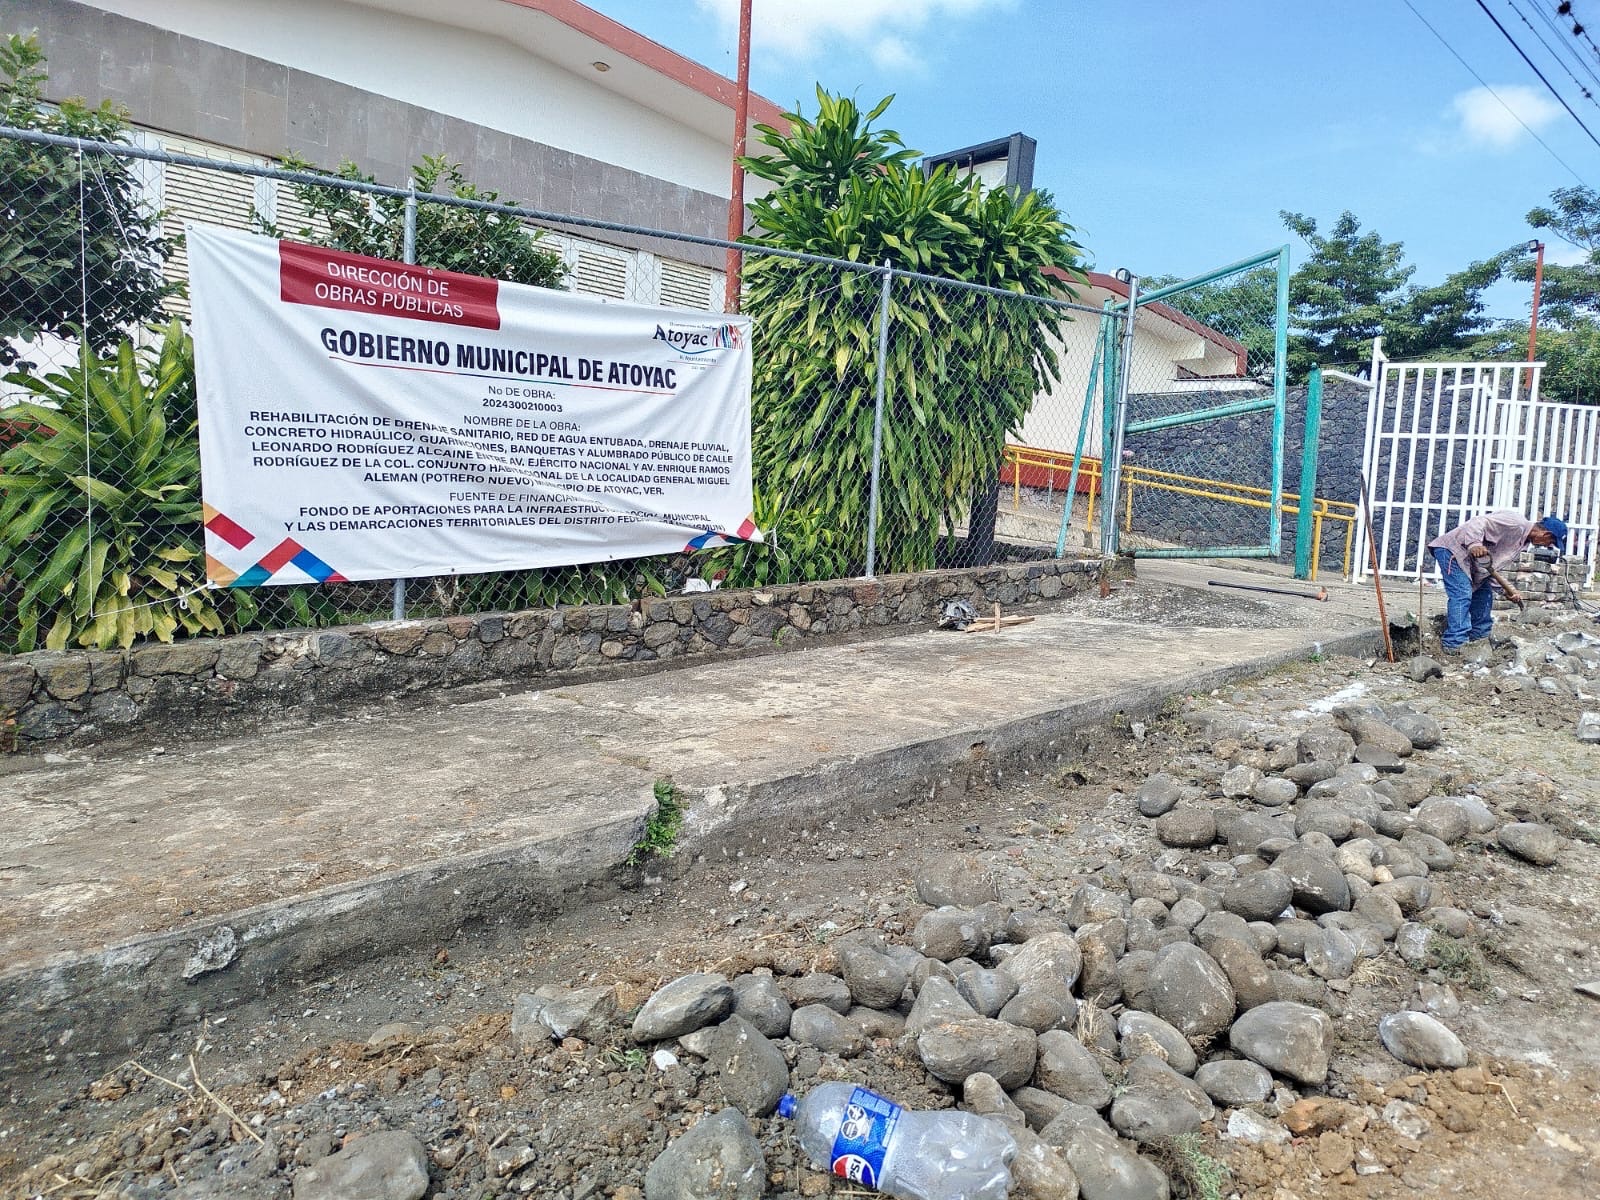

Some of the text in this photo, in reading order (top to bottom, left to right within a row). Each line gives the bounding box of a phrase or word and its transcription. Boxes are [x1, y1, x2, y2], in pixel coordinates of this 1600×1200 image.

[327, 262, 450, 297] DIRECCIÓN DE
[315, 282, 464, 318] OBRAS PÚBLICAS
[652, 323, 708, 350] Atoyac
[320, 327, 677, 390] GOBIERNO MUNICIPAL DE ATOYAC
[482, 398, 563, 412] 2024300210003
[488, 385, 556, 400] No DE OBRA:
[249, 411, 369, 426] REHABILITACIÓN
[372, 416, 391, 427] DE
[450, 427, 514, 442] SANITARIO,
[516, 431, 539, 442] RED
[541, 433, 556, 443] DE
[558, 434, 587, 445] AGUA
[590, 436, 647, 449] ENTUBADA,
[649, 440, 689, 451] DRENAJE
[691, 442, 729, 453] PLUVIAL,
[463, 415, 581, 432] NOMBRE DE LA OBRA:
[244, 426, 327, 438] CONCRETO
[331, 428, 416, 442] HIDRAÚLICO,
[510, 444, 576, 456] BANQUETAS
[578, 448, 585, 457] Y
[587, 449, 649, 460] ALUMBRADO
[651, 450, 691, 462] PÚBLICO
[693, 454, 704, 463] DE
[706, 454, 733, 463] CALLE
[252, 441, 333, 453] LEONARDO
[337, 443, 414, 455] RODRÍGUEZ
[417, 446, 474, 459] ALCAINE
[509, 458, 525, 467] AV.
[528, 457, 577, 469] EJÉRCITO
[580, 460, 631, 471] NACIONAL
[633, 463, 640, 471] Y
[641, 463, 656, 472] AV.
[657, 464, 697, 474] ENRIQUE
[699, 466, 730, 475] RAMOS
[253, 455, 338, 467] RODRÍGUEZ
[342, 458, 361, 468] DE
[365, 458, 381, 468] LA
[384, 459, 414, 469] COL.
[417, 459, 486, 472] CONJUNTO
[565, 472, 579, 481] DE
[581, 472, 594, 481] LA
[596, 473, 651, 483] LOCALIDAD
[653, 475, 695, 485] GENERAL
[697, 477, 731, 486] MIGUEL
[363, 472, 418, 482] ALEMAN
[421, 473, 485, 484] (POTRERO
[488, 476, 534, 487] NUEVO)
[586, 484, 601, 493] DE
[603, 485, 642, 496] ATOYAC,
[643, 486, 665, 496] VER.
[449, 492, 496, 502] FUENTE
[498, 493, 515, 502] DE
[284, 521, 294, 532] Y
[297, 521, 326, 532] LAS
[329, 519, 443, 531] DEMARCACIONES
[446, 517, 536, 528] TERRITORIALES
[538, 517, 562, 526] DEL
[564, 516, 615, 526] DISTRITO
[299, 506, 349, 517] FONDO
[352, 506, 371, 516] DE
[373, 505, 471, 515] APORTACIONES
[473, 505, 505, 514] PARA
[507, 505, 523, 514] LA
[662, 512, 712, 522] MUNICIPAL
